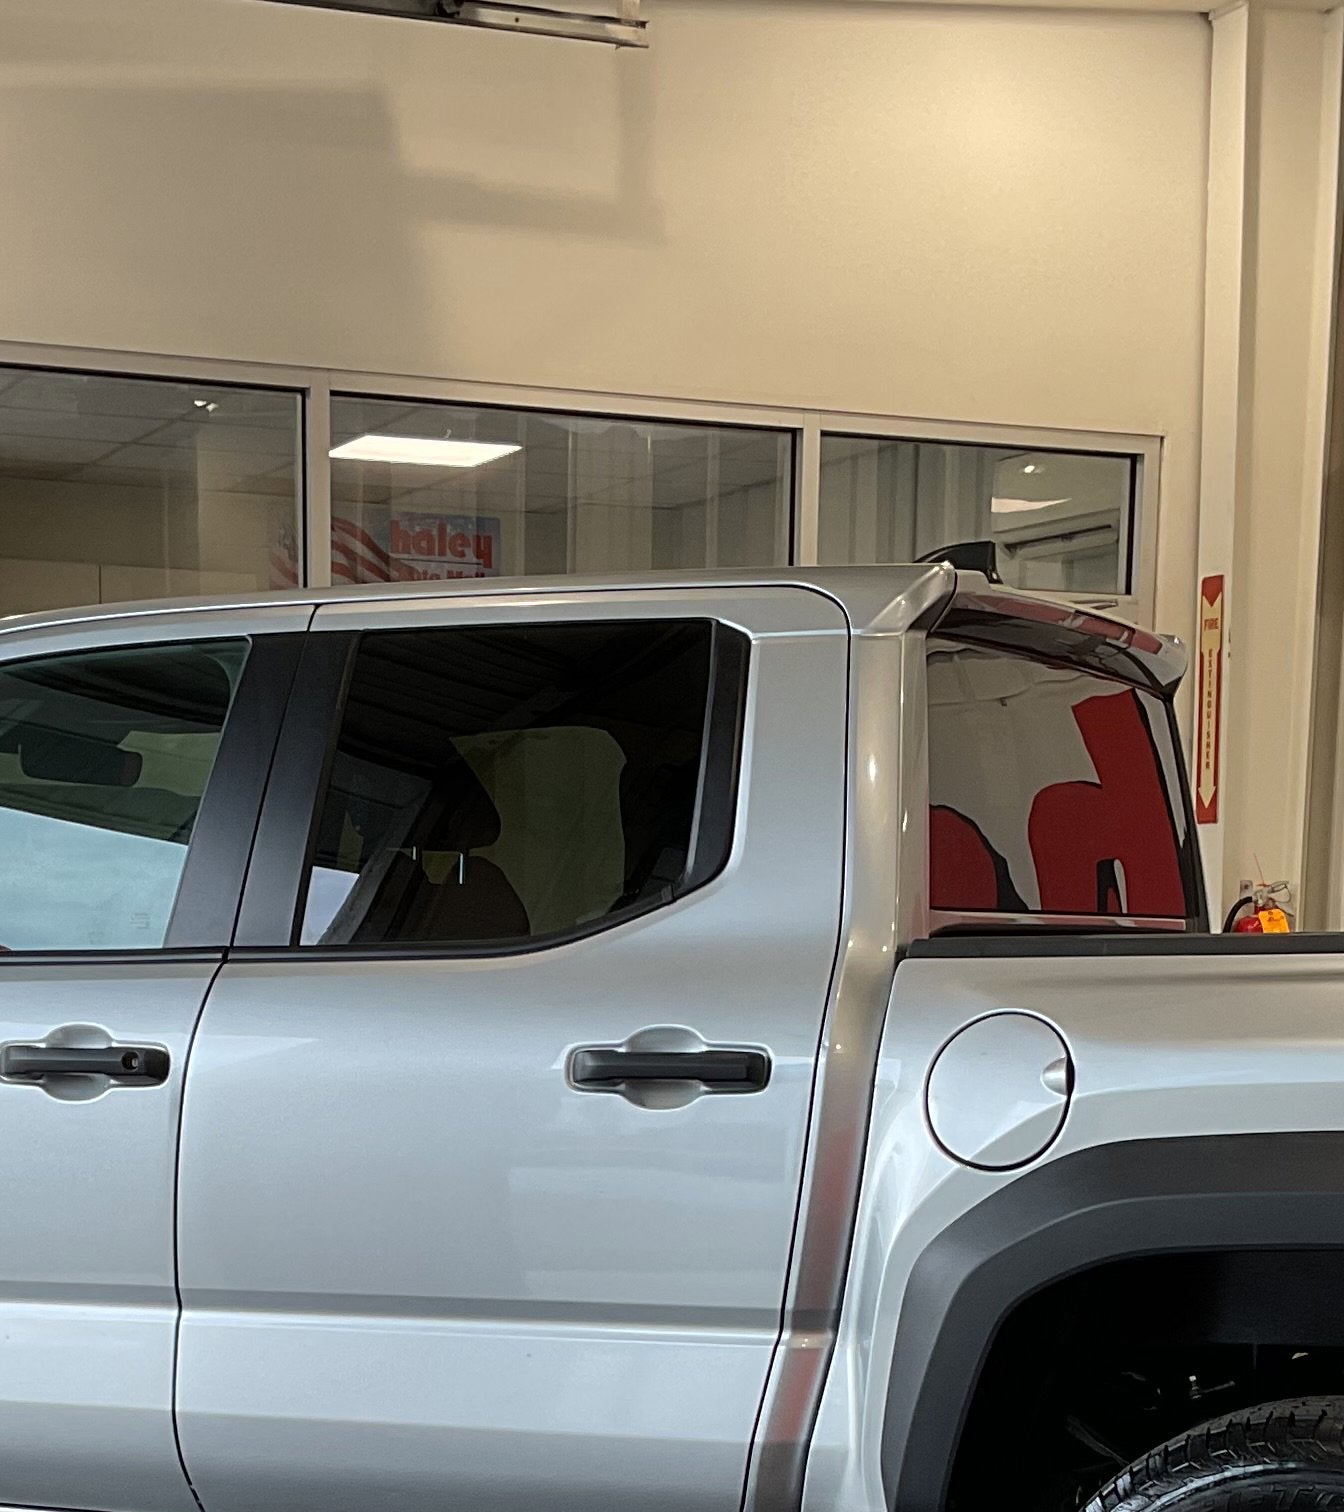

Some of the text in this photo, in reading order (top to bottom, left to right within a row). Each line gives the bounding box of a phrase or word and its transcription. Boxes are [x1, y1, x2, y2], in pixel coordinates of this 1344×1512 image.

[389, 519, 493, 569] haley
[1203, 617, 1219, 631] FIRE
[1204, 648, 1213, 770] EXTINGUISHER
